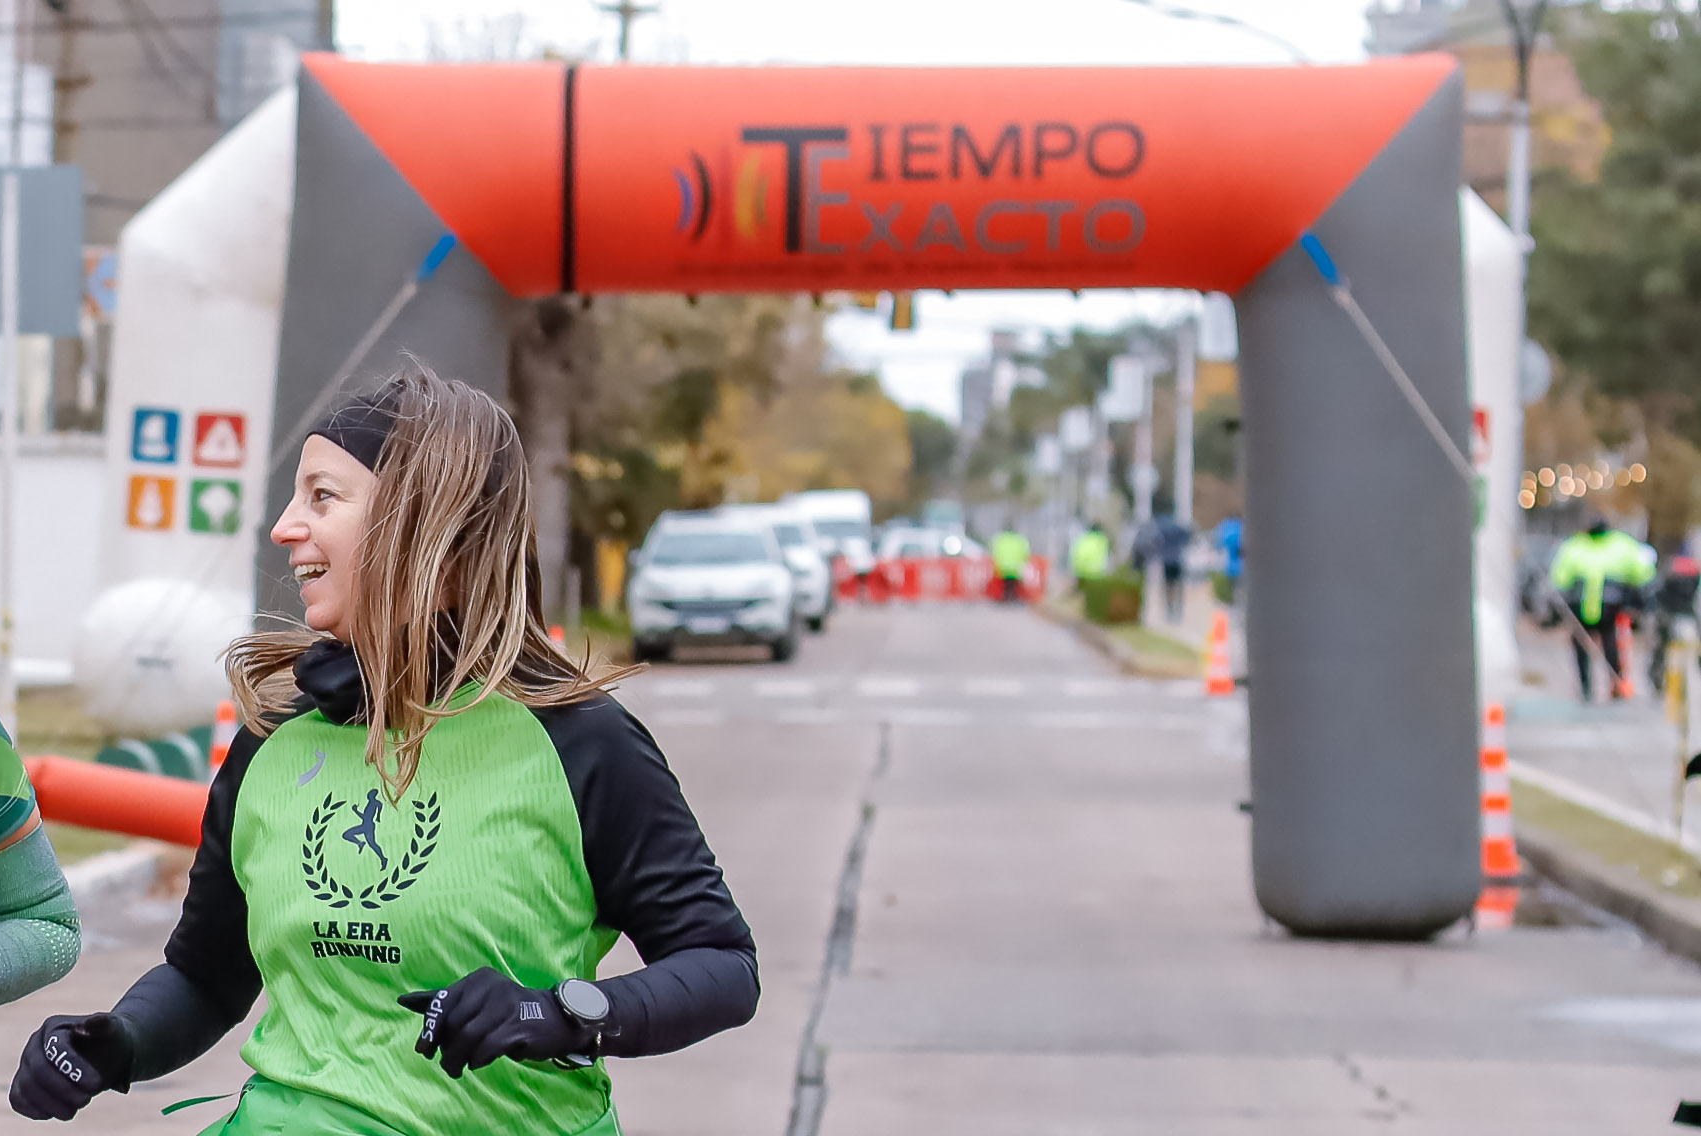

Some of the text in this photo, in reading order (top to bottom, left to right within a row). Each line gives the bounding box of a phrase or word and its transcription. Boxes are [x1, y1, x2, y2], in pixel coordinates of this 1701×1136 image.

[739, 121, 1147, 254] TIEMPO
[805, 147, 1148, 255] EXACTO
[310, 940, 401, 965] RUNNING
[312, 921, 392, 942] LA ERA
